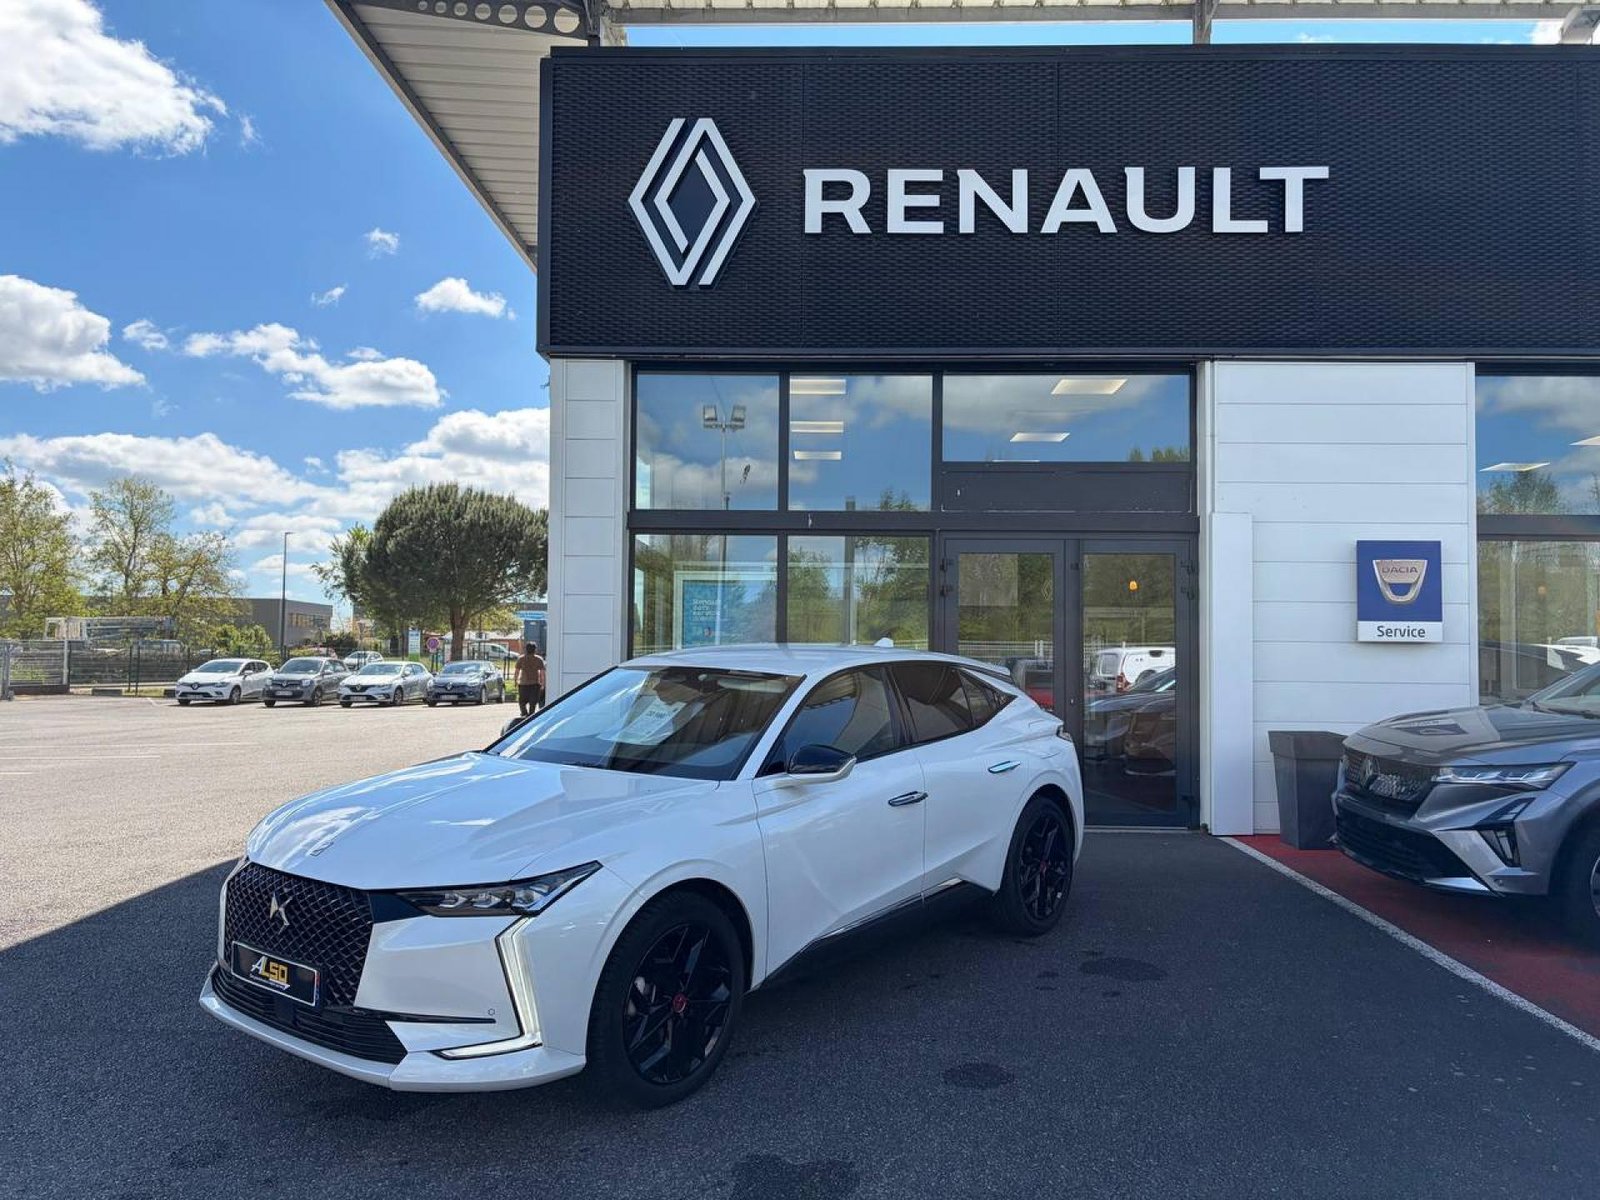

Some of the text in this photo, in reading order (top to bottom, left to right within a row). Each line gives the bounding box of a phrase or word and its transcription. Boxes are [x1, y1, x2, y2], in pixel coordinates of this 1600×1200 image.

[803, 166, 1330, 235] RENAULT
[1381, 565, 1419, 574] DACIA
[1376, 625, 1426, 638] Service
